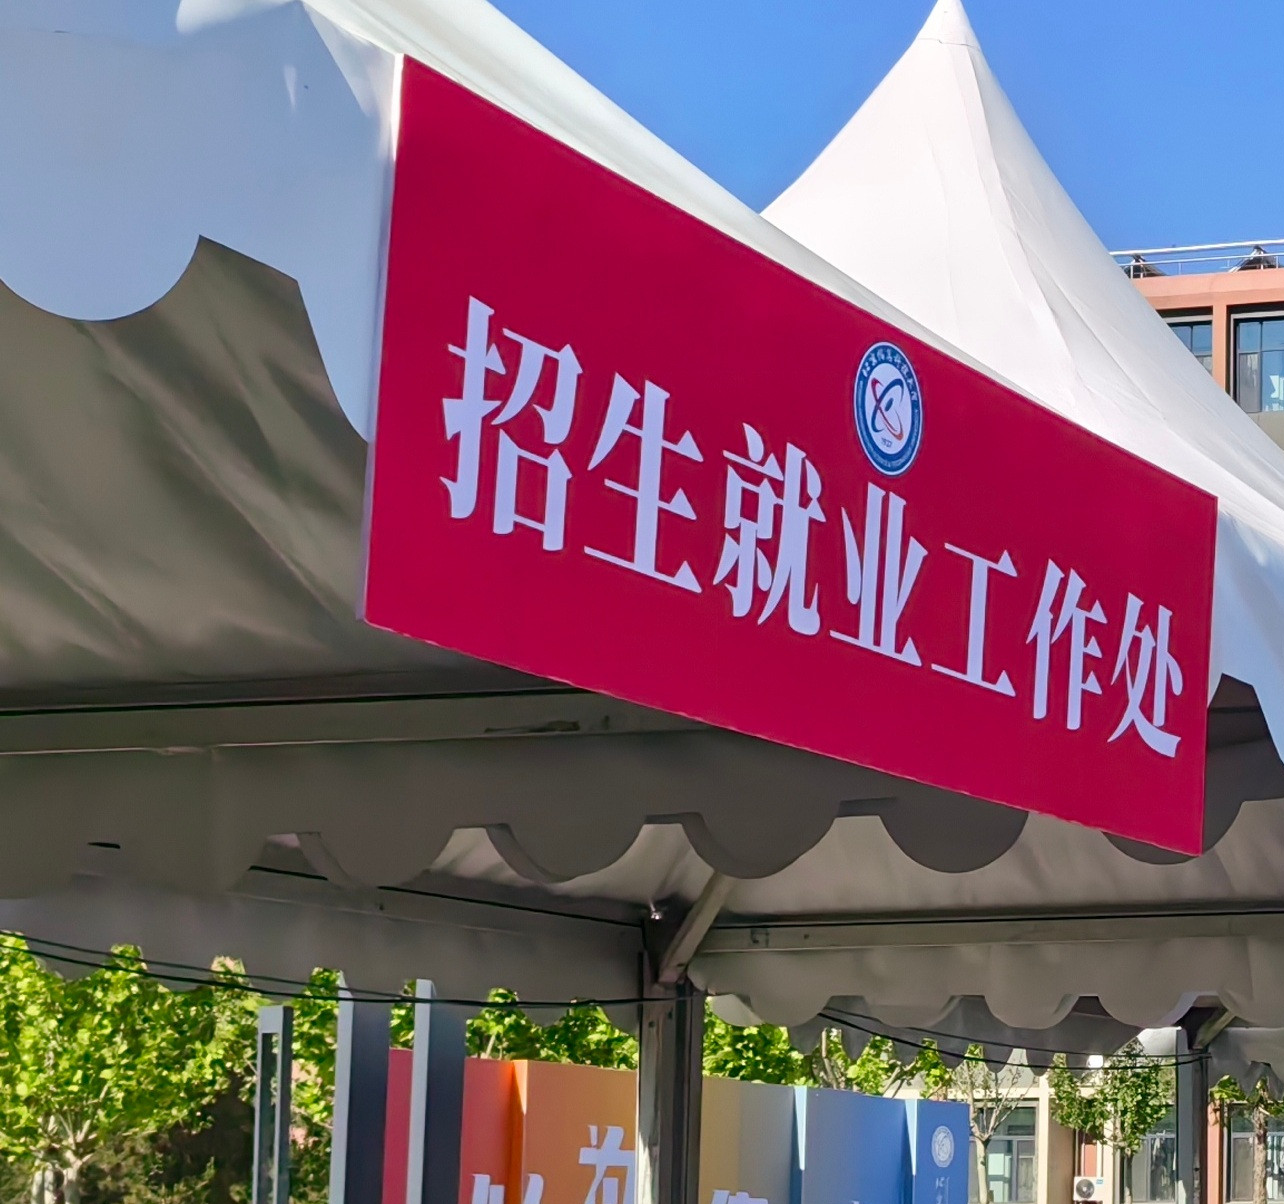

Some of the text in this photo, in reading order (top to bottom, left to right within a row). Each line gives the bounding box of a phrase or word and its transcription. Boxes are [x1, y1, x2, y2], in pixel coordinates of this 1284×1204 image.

[440, 297, 1183, 759] 招生就业工作处
